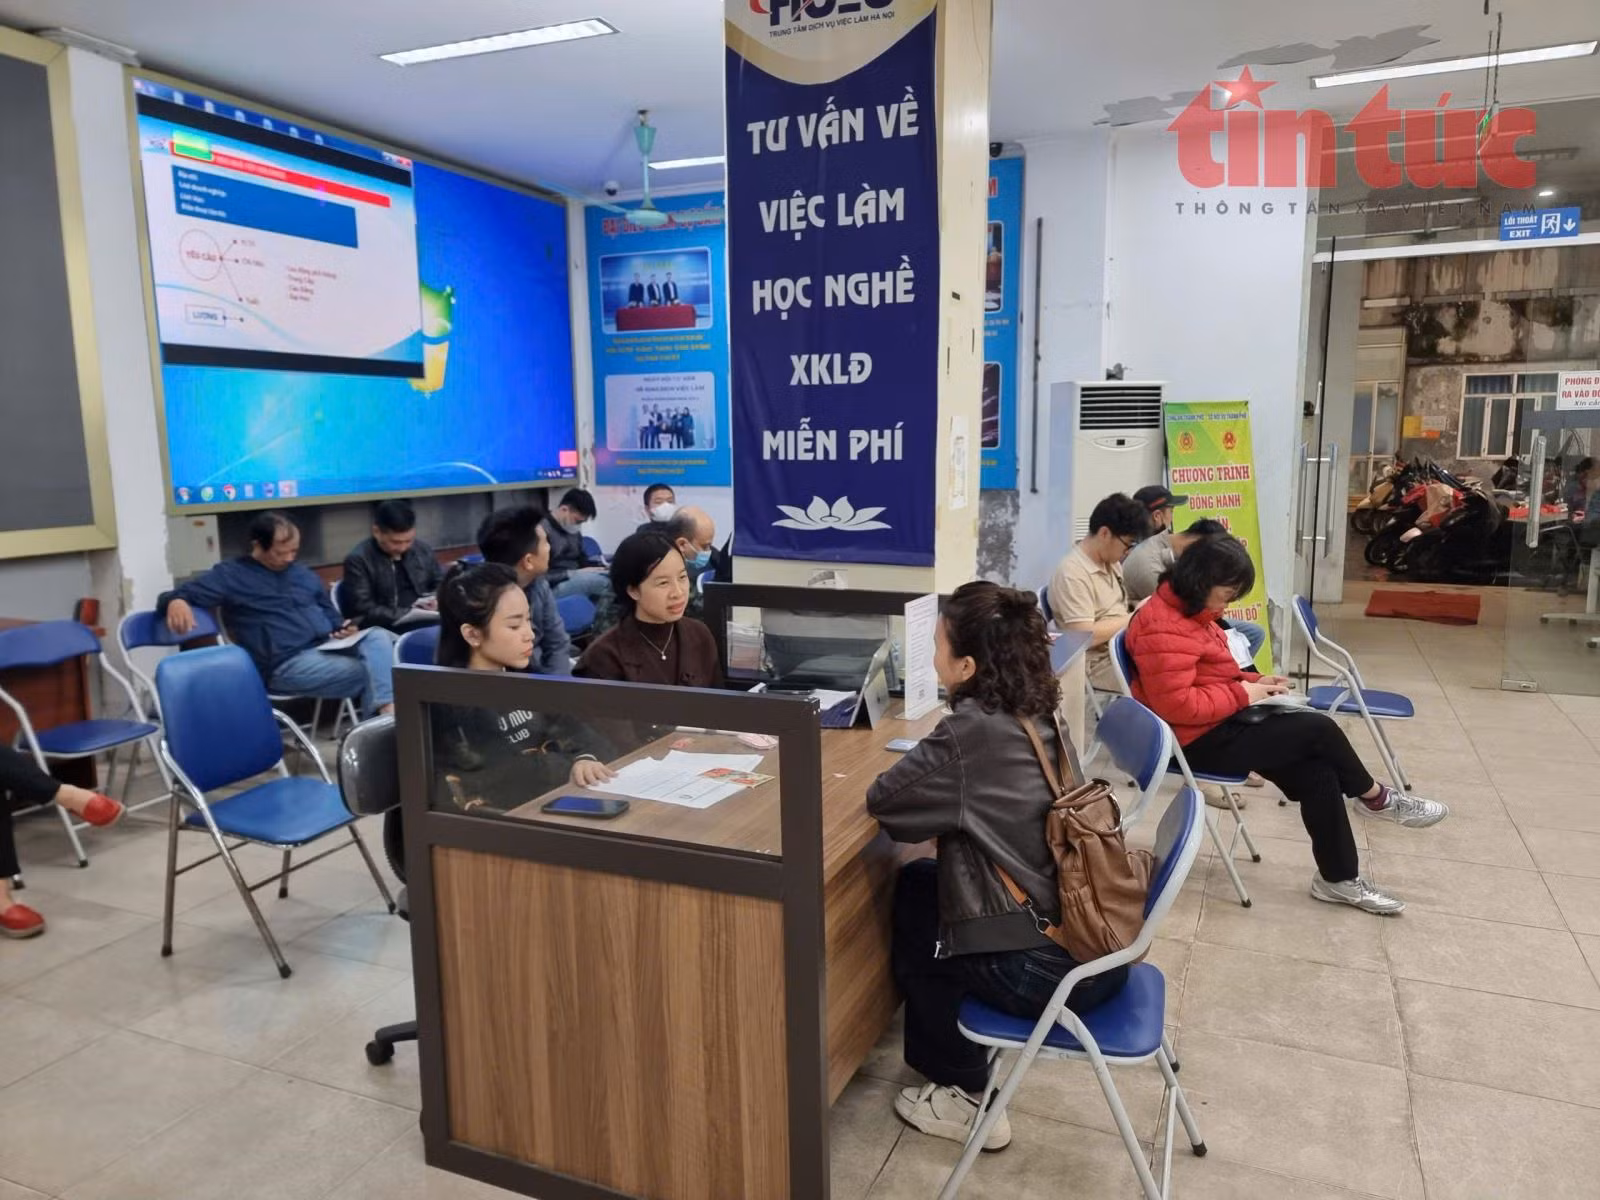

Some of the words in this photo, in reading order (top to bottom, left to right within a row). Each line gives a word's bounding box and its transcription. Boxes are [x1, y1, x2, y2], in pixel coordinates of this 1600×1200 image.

[769, 28, 792, 38] TRUNG
[836, 17, 853, 26] VIỆC
[747, 116, 790, 155] TƯ
[797, 96, 864, 150] VẤN
[876, 86, 919, 139] VỀ
[759, 190, 826, 241] VIỆC
[837, 183, 905, 228] LÀM
[1509, 229, 1532, 239] EXIT
[752, 276, 812, 320] HỌC
[824, 255, 915, 309] NGHỀ
[789, 352, 873, 386] XKLĐ
[1561, 390, 1572, 399] RA
[763, 417, 837, 460] MIỄN
[849, 421, 904, 464] PHÍ
